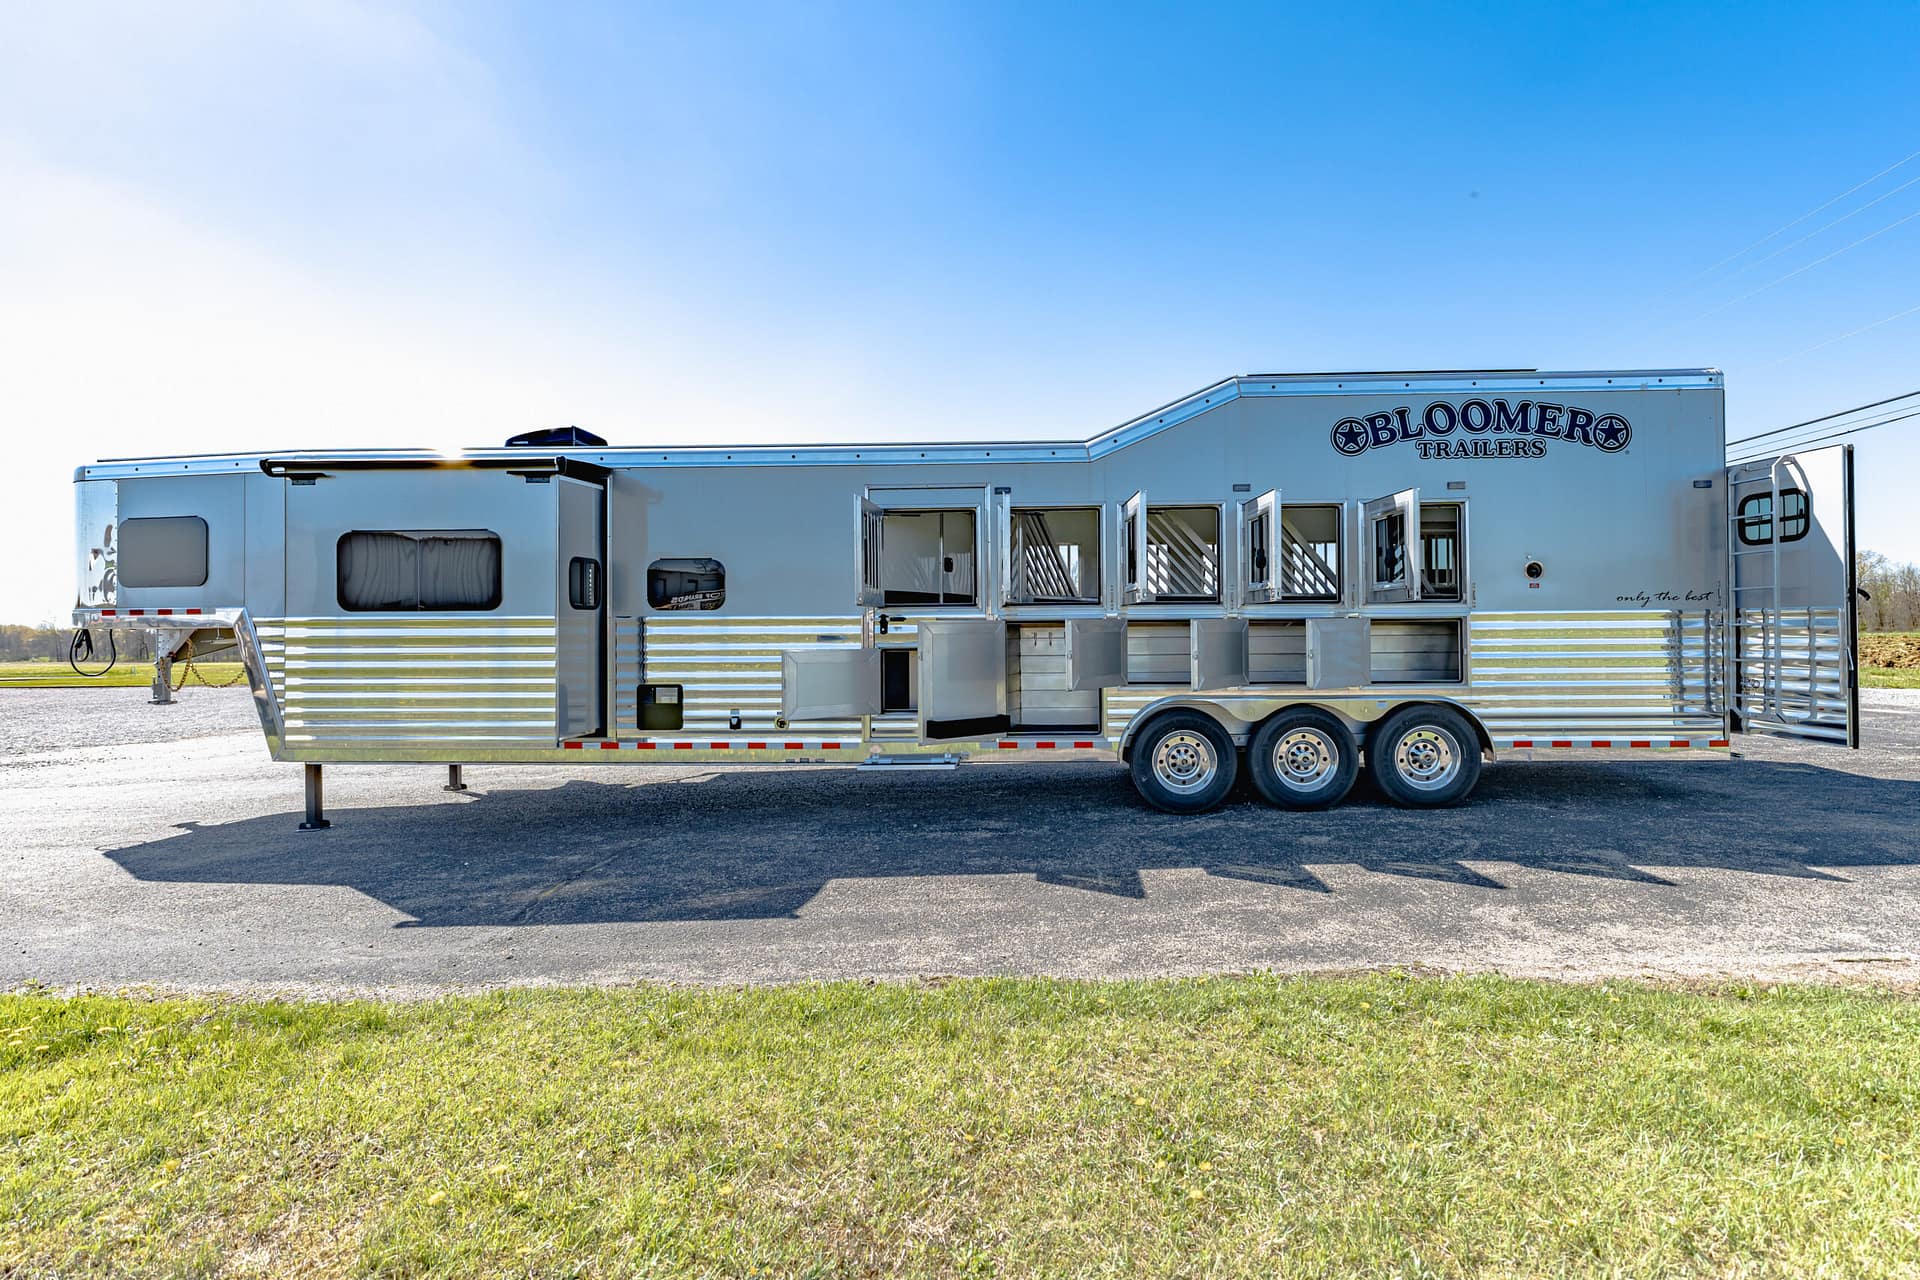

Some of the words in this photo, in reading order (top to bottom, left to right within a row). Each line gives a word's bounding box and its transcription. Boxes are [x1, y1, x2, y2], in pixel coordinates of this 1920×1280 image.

[1364, 399, 1596, 448] BLOOMER
[1416, 438, 1547, 459] TRAILERS
[1616, 590, 1651, 608] only
[1653, 590, 1681, 601] the
[1684, 590, 1714, 601] best
